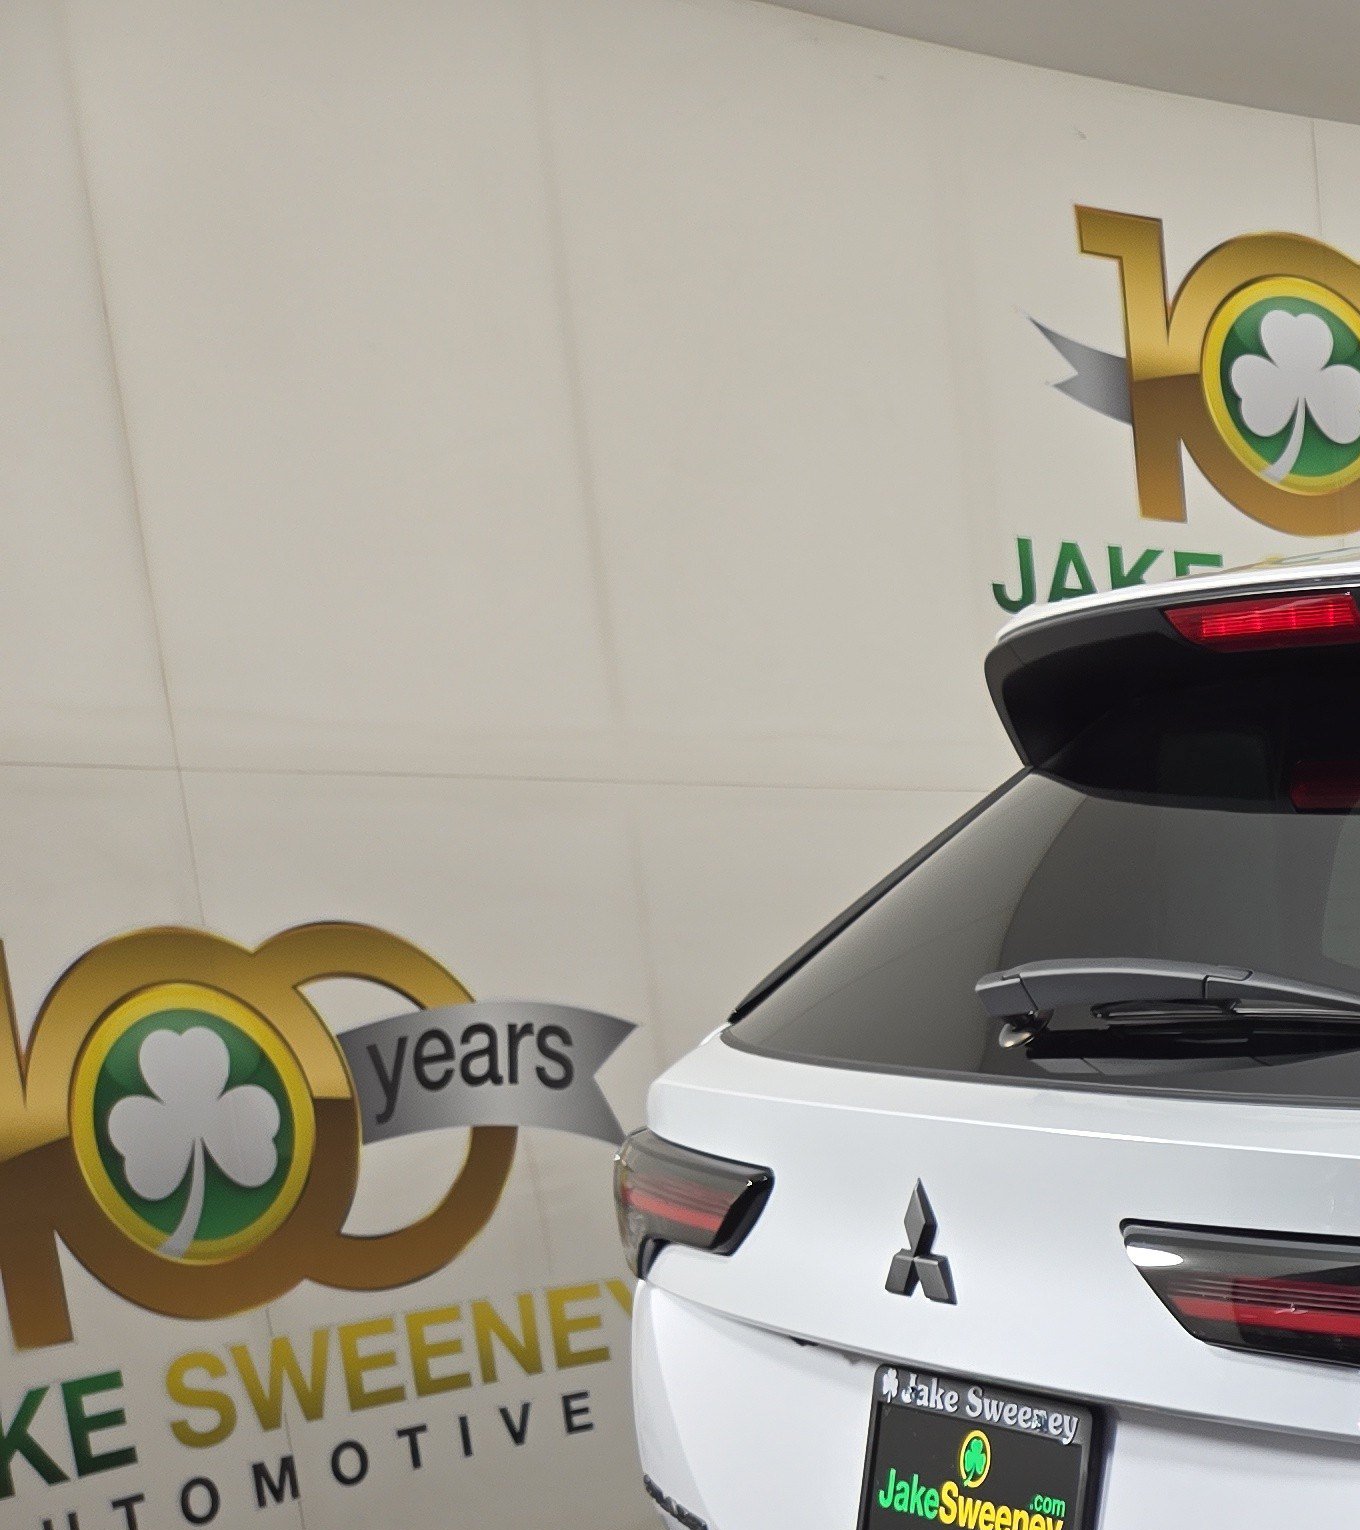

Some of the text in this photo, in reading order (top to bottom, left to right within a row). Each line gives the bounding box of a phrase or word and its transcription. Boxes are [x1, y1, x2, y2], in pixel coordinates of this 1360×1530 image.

[366, 1022, 575, 1125] years
[165, 1276, 633, 1449] SWEENE
[901, 1373, 1079, 1445] Jake Sweeney
